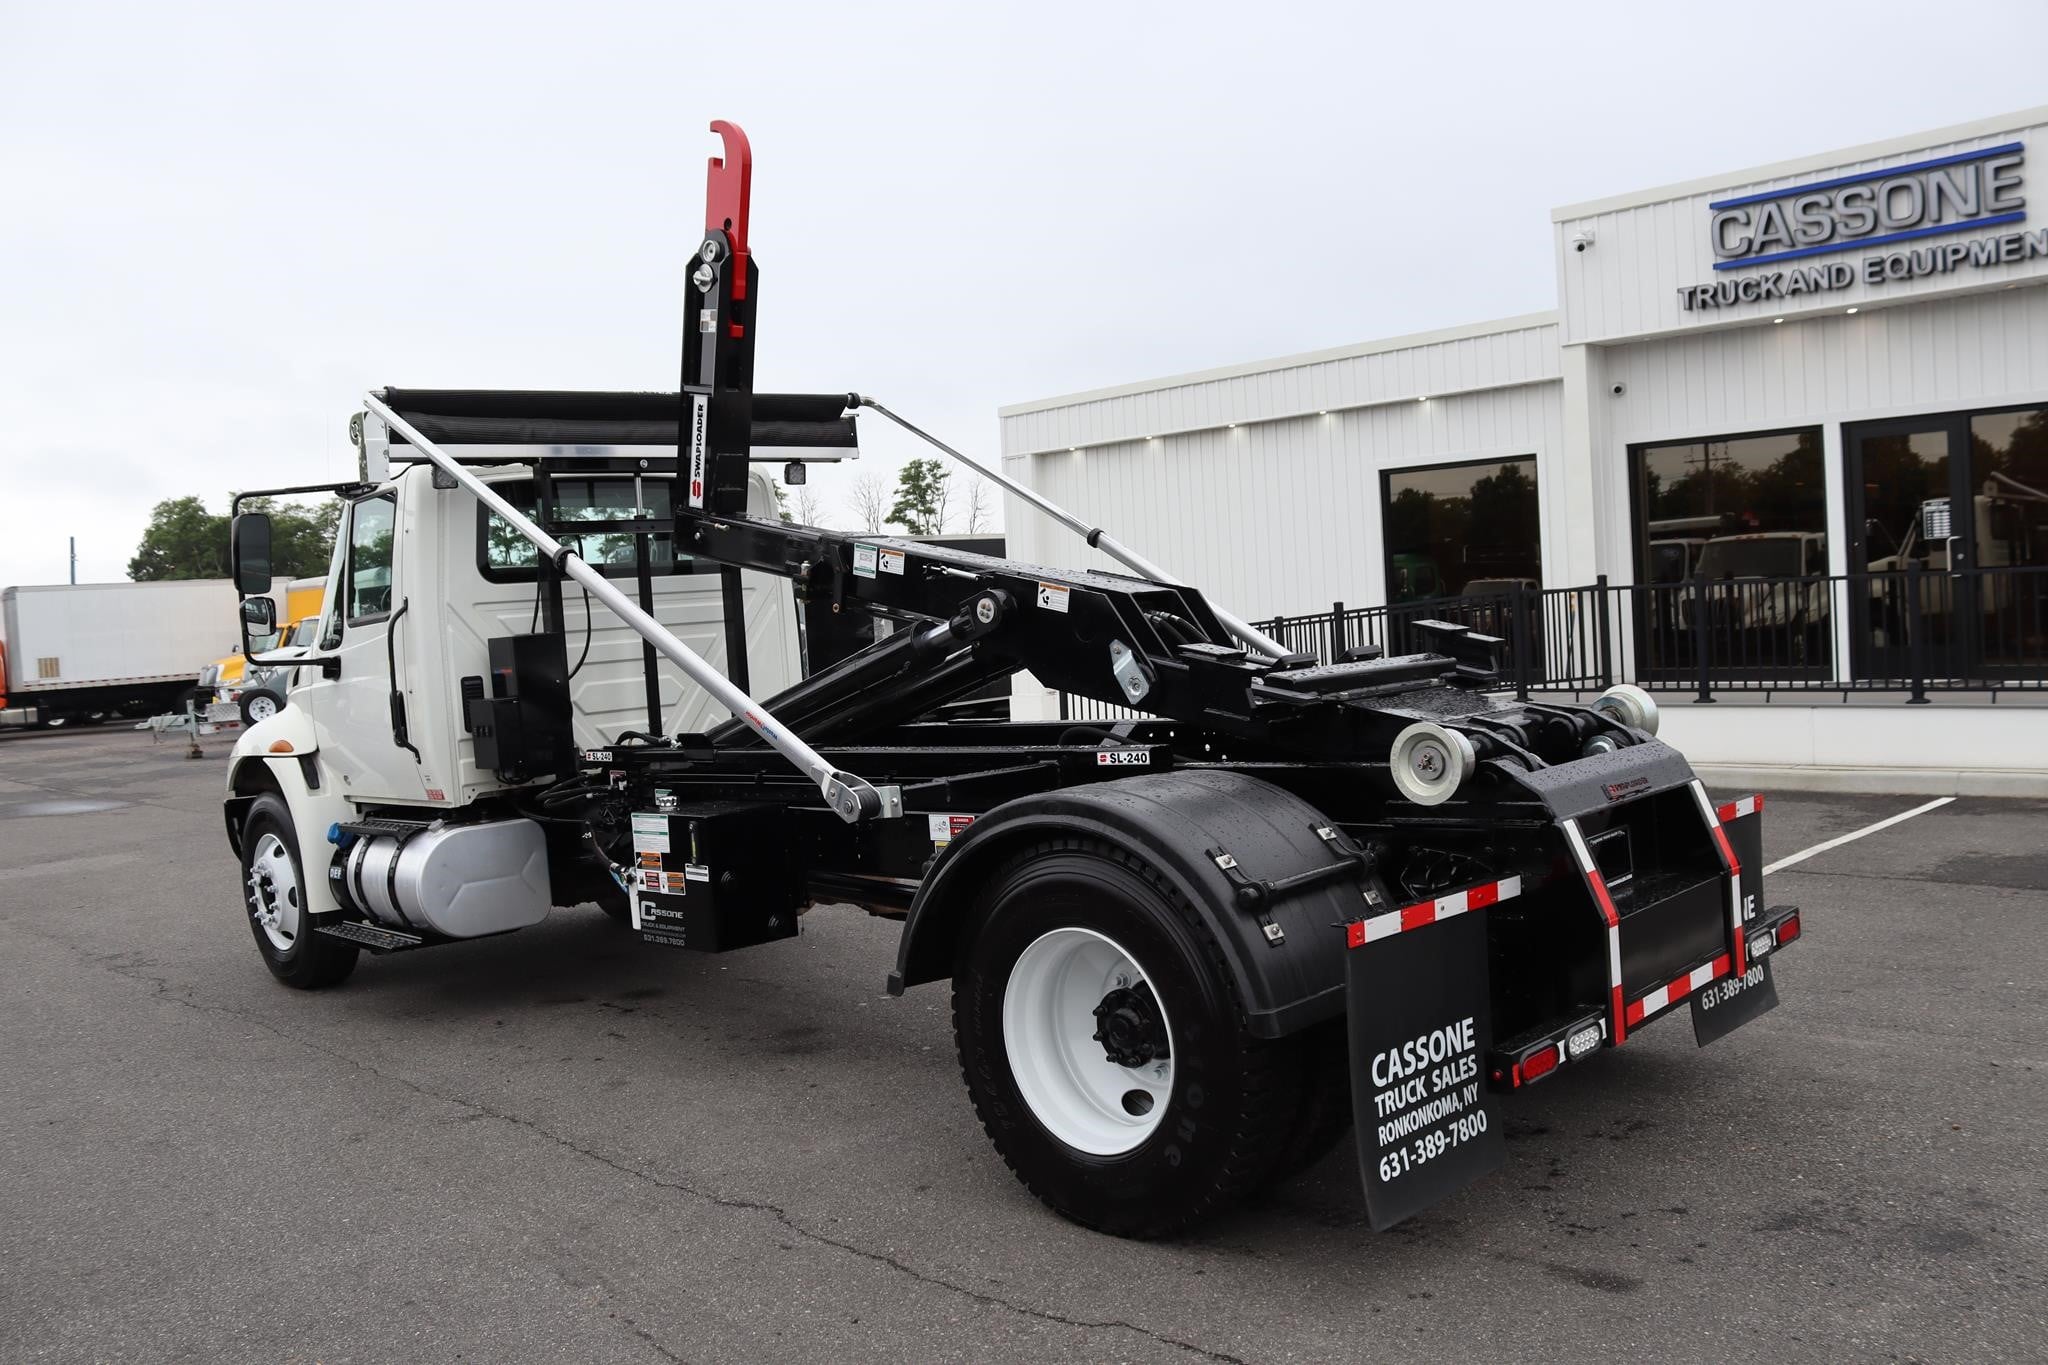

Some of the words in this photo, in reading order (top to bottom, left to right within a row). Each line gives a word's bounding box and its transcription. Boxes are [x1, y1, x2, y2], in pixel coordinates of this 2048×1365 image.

[1711, 154, 2026, 260] CASSONE
[1677, 272, 1784, 311] TRUCK
[1782, 262, 1855, 297] AND
[1861, 228, 2048, 284] EQUIPMEN
[694, 403, 704, 478] SWAPLOADER
[1110, 753, 1147, 763] SL-240
[330, 866, 342, 879] DEF
[1702, 964, 1764, 1010] 631-389-7800
[1371, 1016, 1476, 1088] CASSONE
[1374, 1075, 1428, 1118] TRUCK
[1432, 1054, 1478, 1092] SALES
[1378, 1091, 1464, 1147] RONKONKOMA,
[1463, 1082, 1479, 1106] NY
[1379, 1109, 1487, 1182] 631-389-7800
